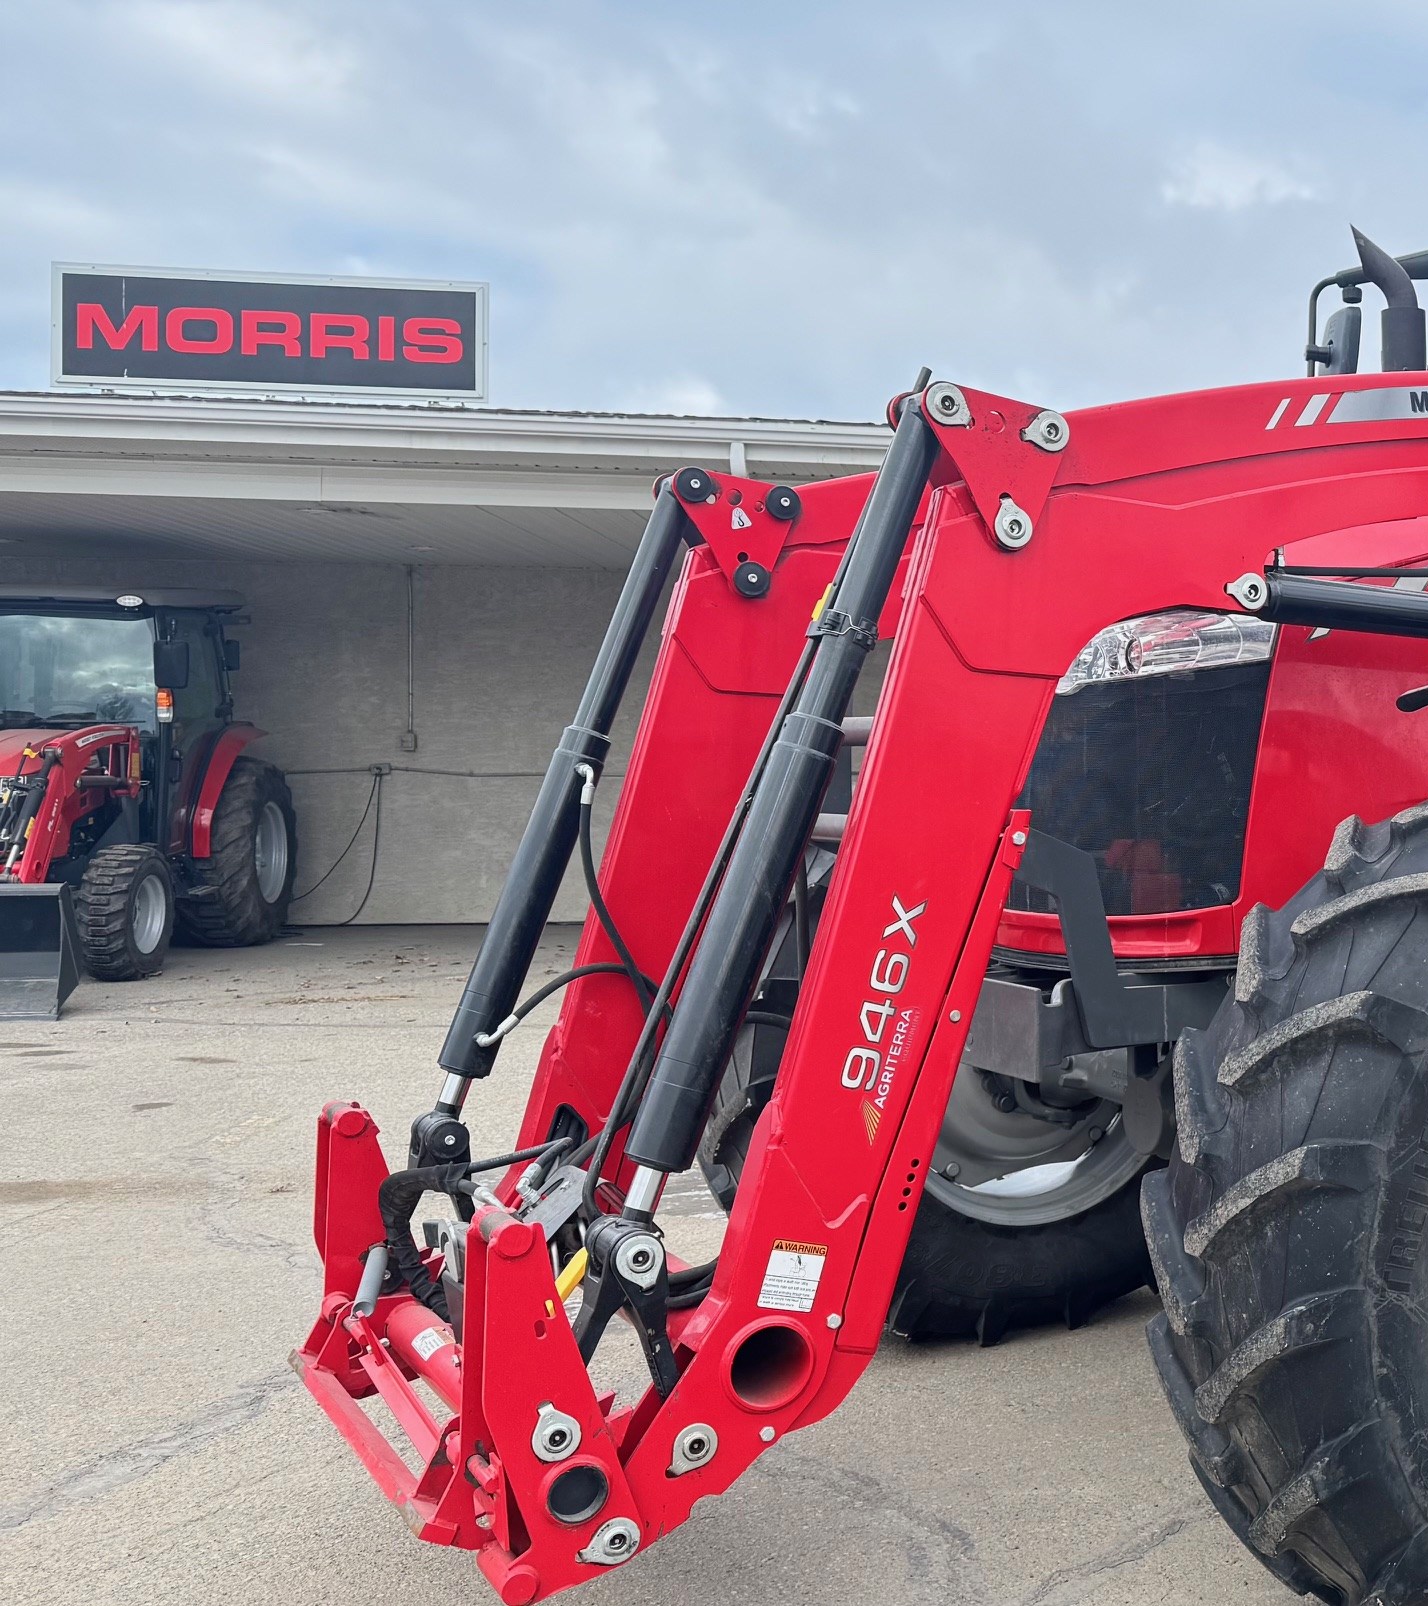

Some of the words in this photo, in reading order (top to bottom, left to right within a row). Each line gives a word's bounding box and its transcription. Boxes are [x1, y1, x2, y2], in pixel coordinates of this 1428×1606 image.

[76, 303, 463, 363] MORRIS
[874, 1009, 914, 1110] AGRITERRA
[785, 1242, 826, 1255] WARNING
